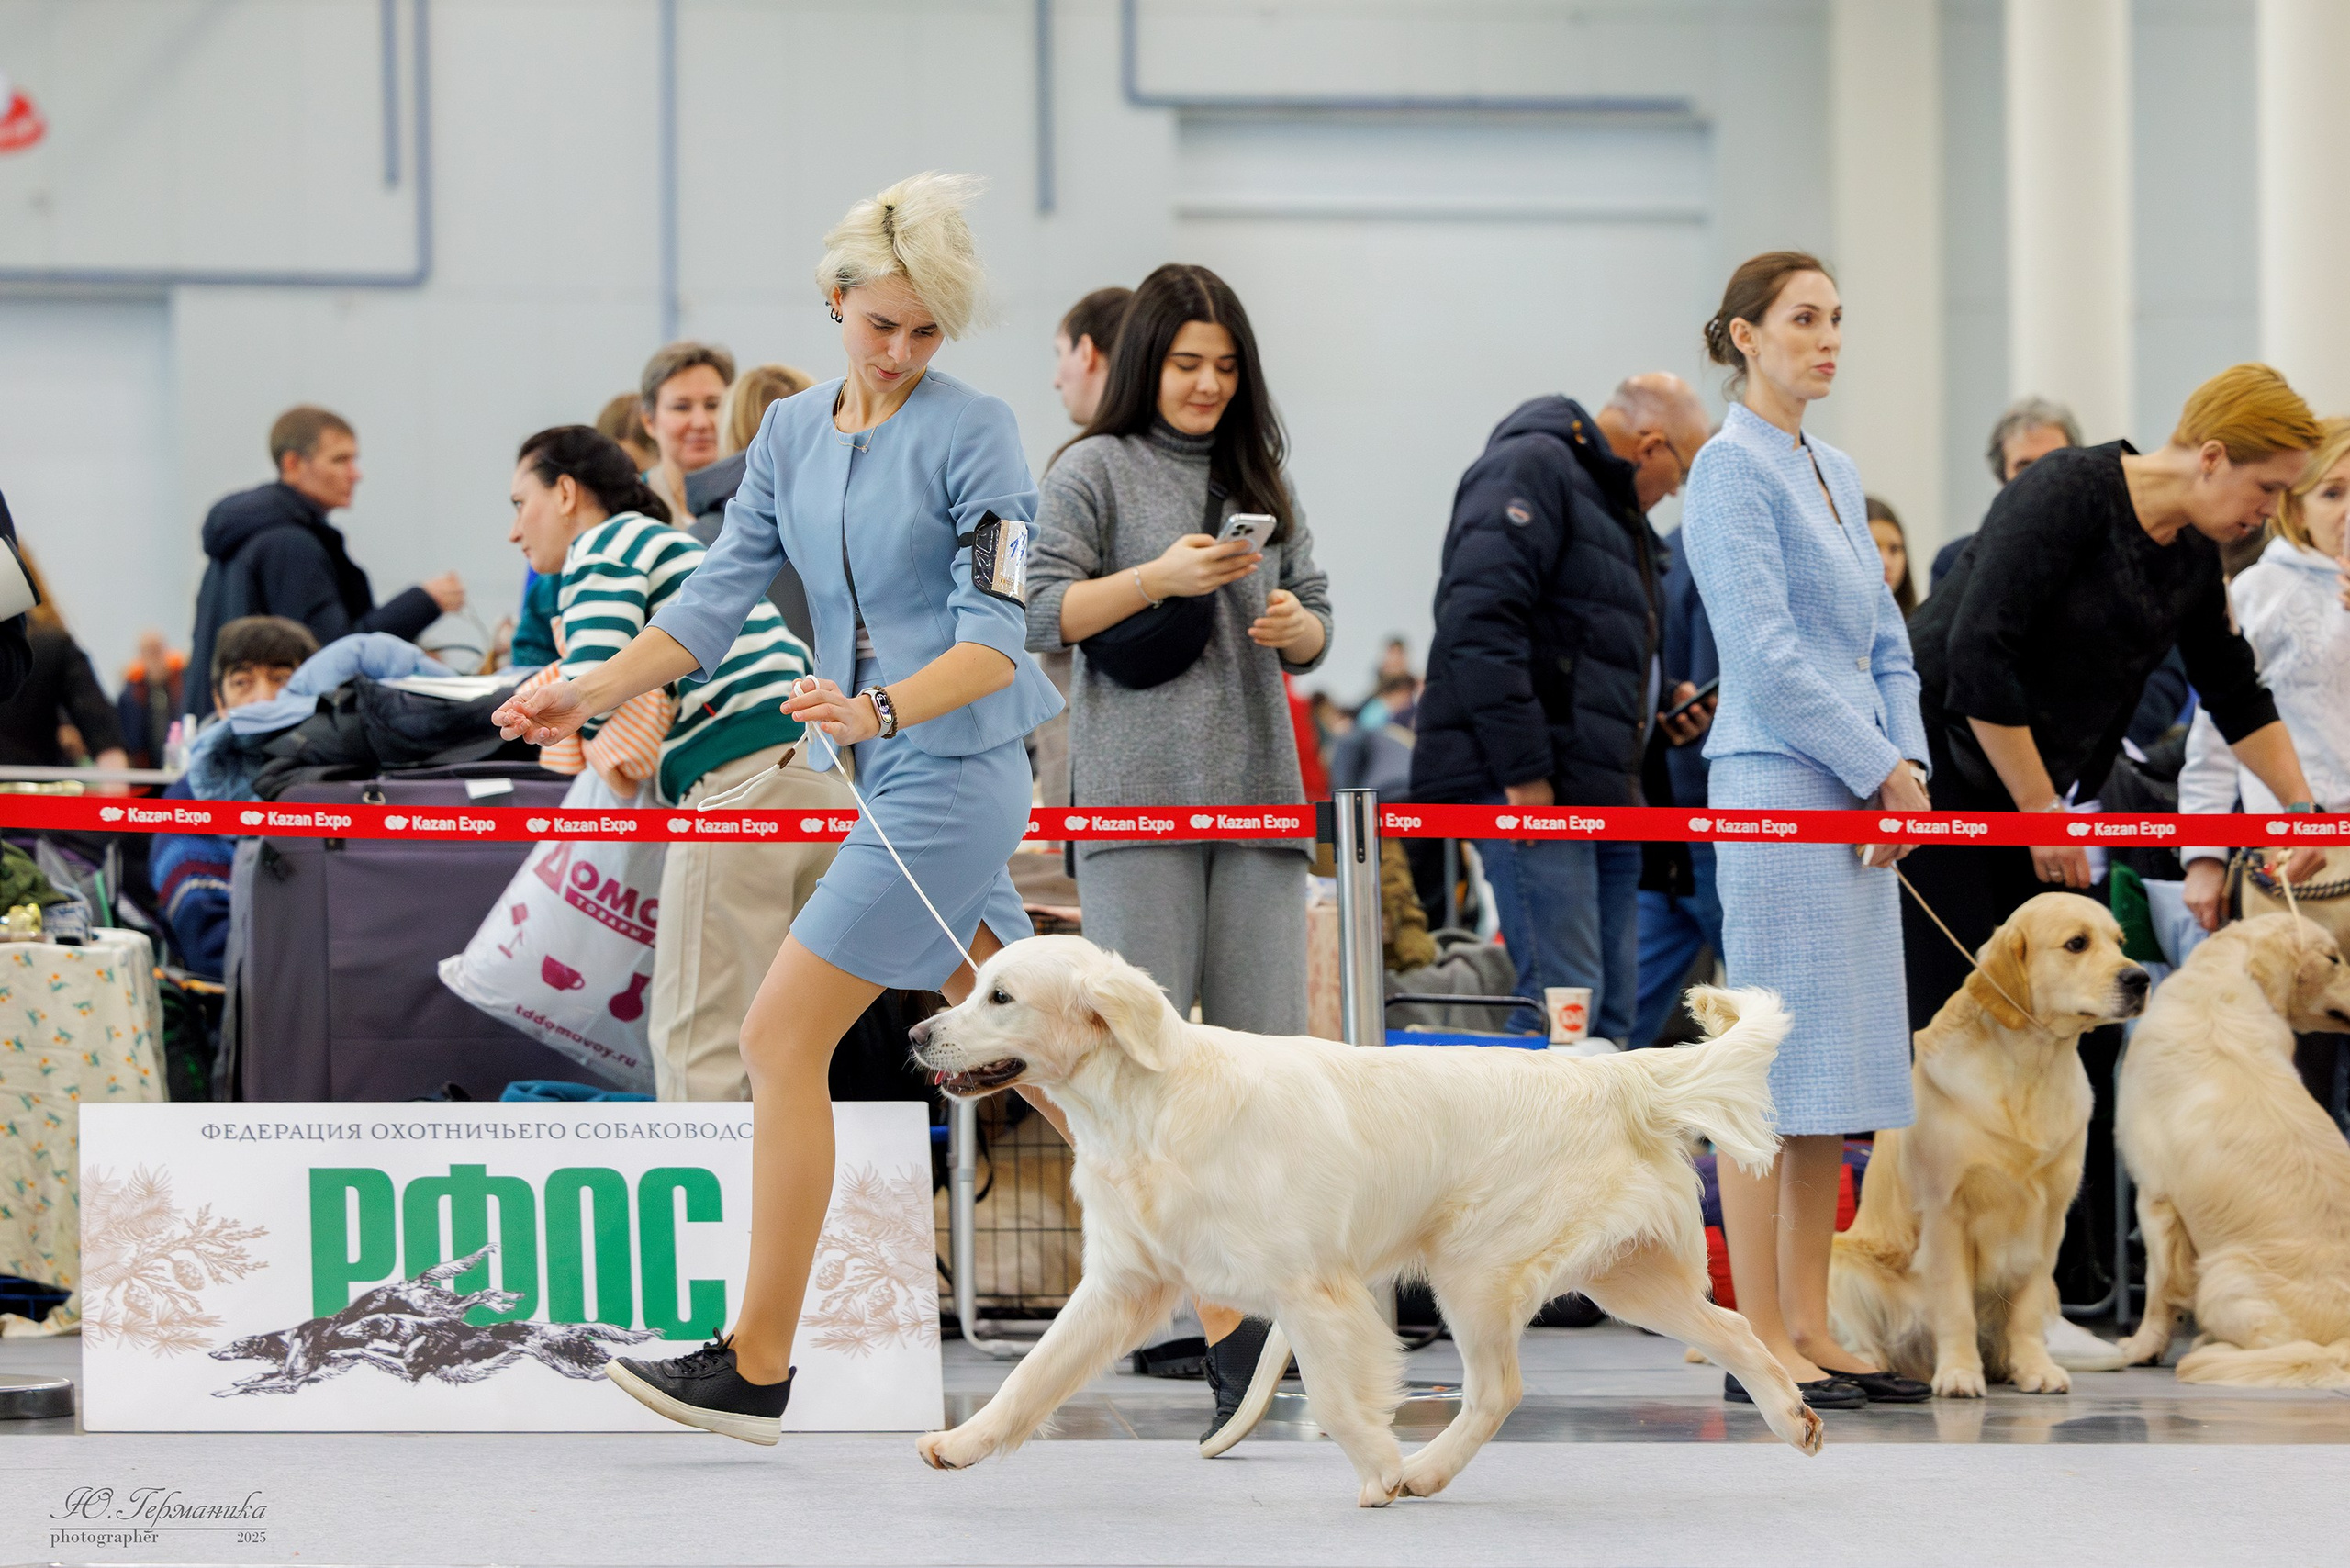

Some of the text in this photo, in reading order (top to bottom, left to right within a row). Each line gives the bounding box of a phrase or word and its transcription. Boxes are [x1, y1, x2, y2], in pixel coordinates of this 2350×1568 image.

[128, 808, 212, 826] Kazan Expo
[268, 812, 352, 831] Kazan Expo
[412, 816, 496, 834] Kazan Expo
[554, 817, 638, 835] Kazan Expo
[1092, 816, 1175, 834] Kazan Expo
[1217, 814, 1300, 833] Kazan Expo
[1385, 813, 1422, 831] Expo
[1523, 815, 1606, 834] Kazan Expo
[696, 819, 778, 836] Kazan Expo
[1716, 818, 1798, 837] Kazan Expo
[1907, 819, 1988, 838] Kazan Expo
[2095, 821, 2177, 839] Kazan Expo
[2293, 821, 2337, 835] Kazan
[201, 1121, 753, 1142] ФЕДЕРАЦИЯ ОХОТНИЧЬЕГО СОБАКОВОДС
[308, 1162, 726, 1341] РФОС
